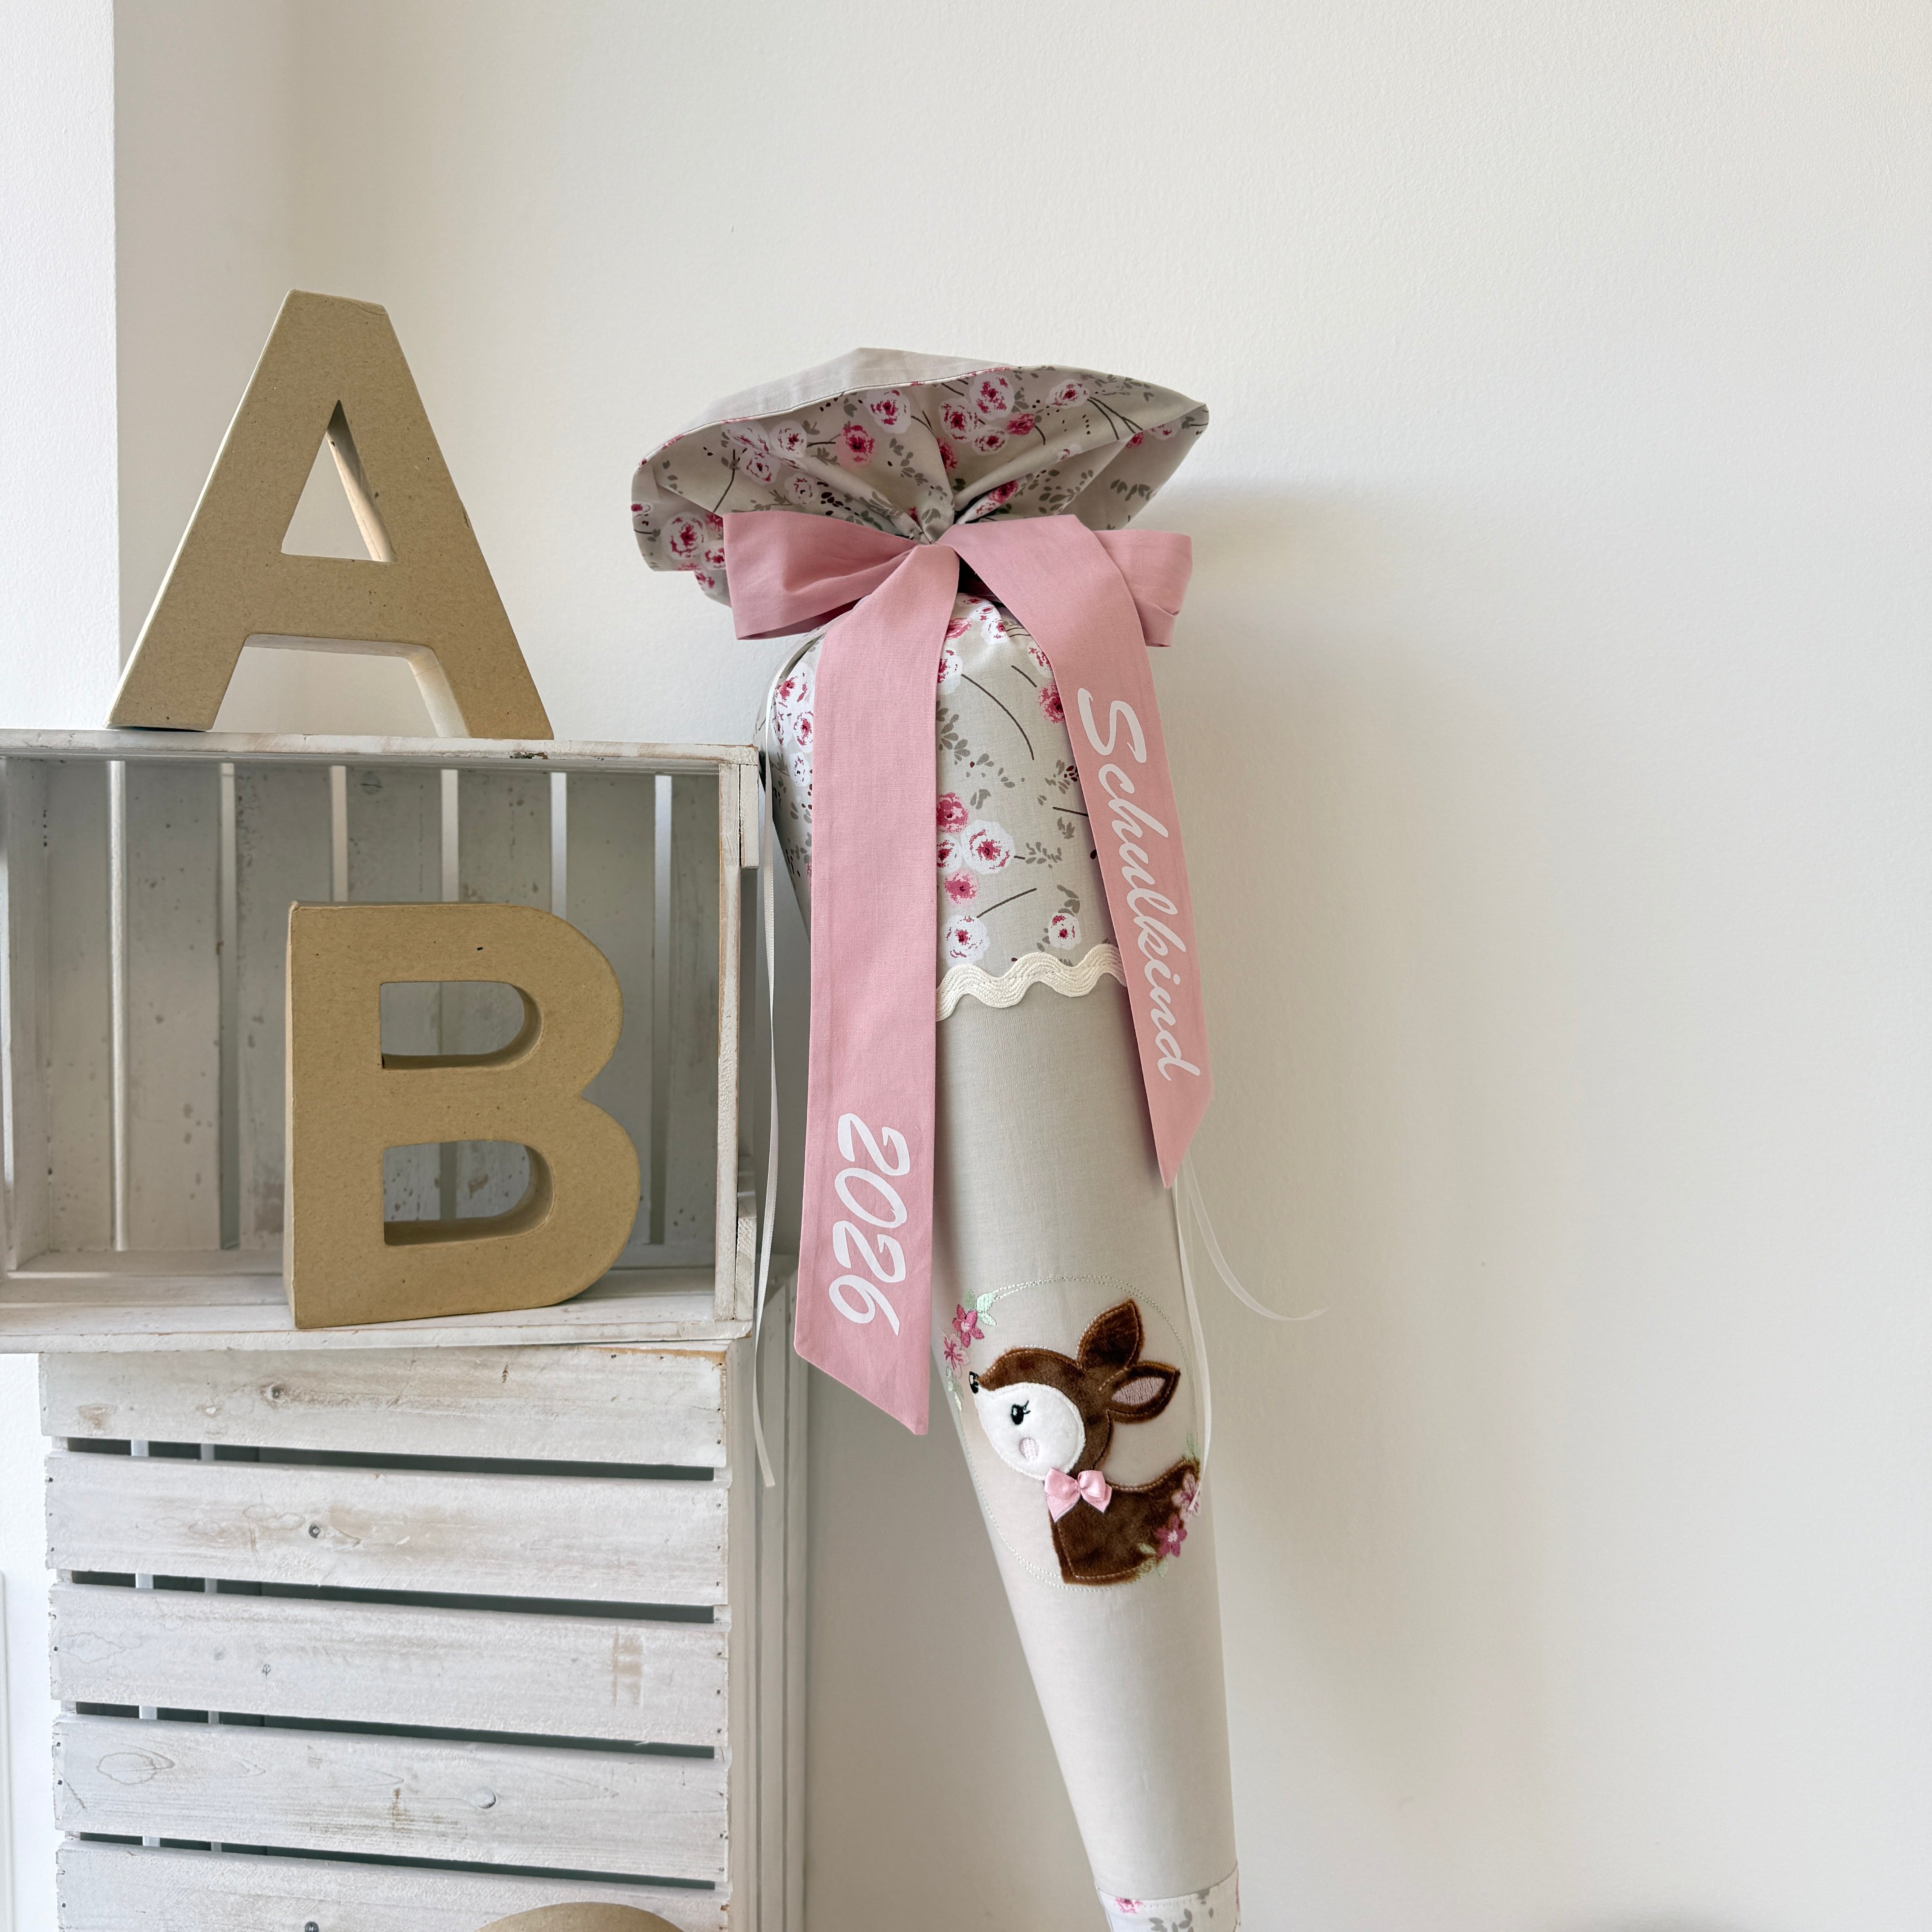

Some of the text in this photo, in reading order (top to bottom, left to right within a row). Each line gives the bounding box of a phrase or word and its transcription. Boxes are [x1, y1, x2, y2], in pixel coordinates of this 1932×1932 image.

[108, 289, 554, 740] A
[1077, 688, 1201, 1082] Schulkind
[283, 901, 640, 1329] B
[829, 1113, 911, 1336] 2026
